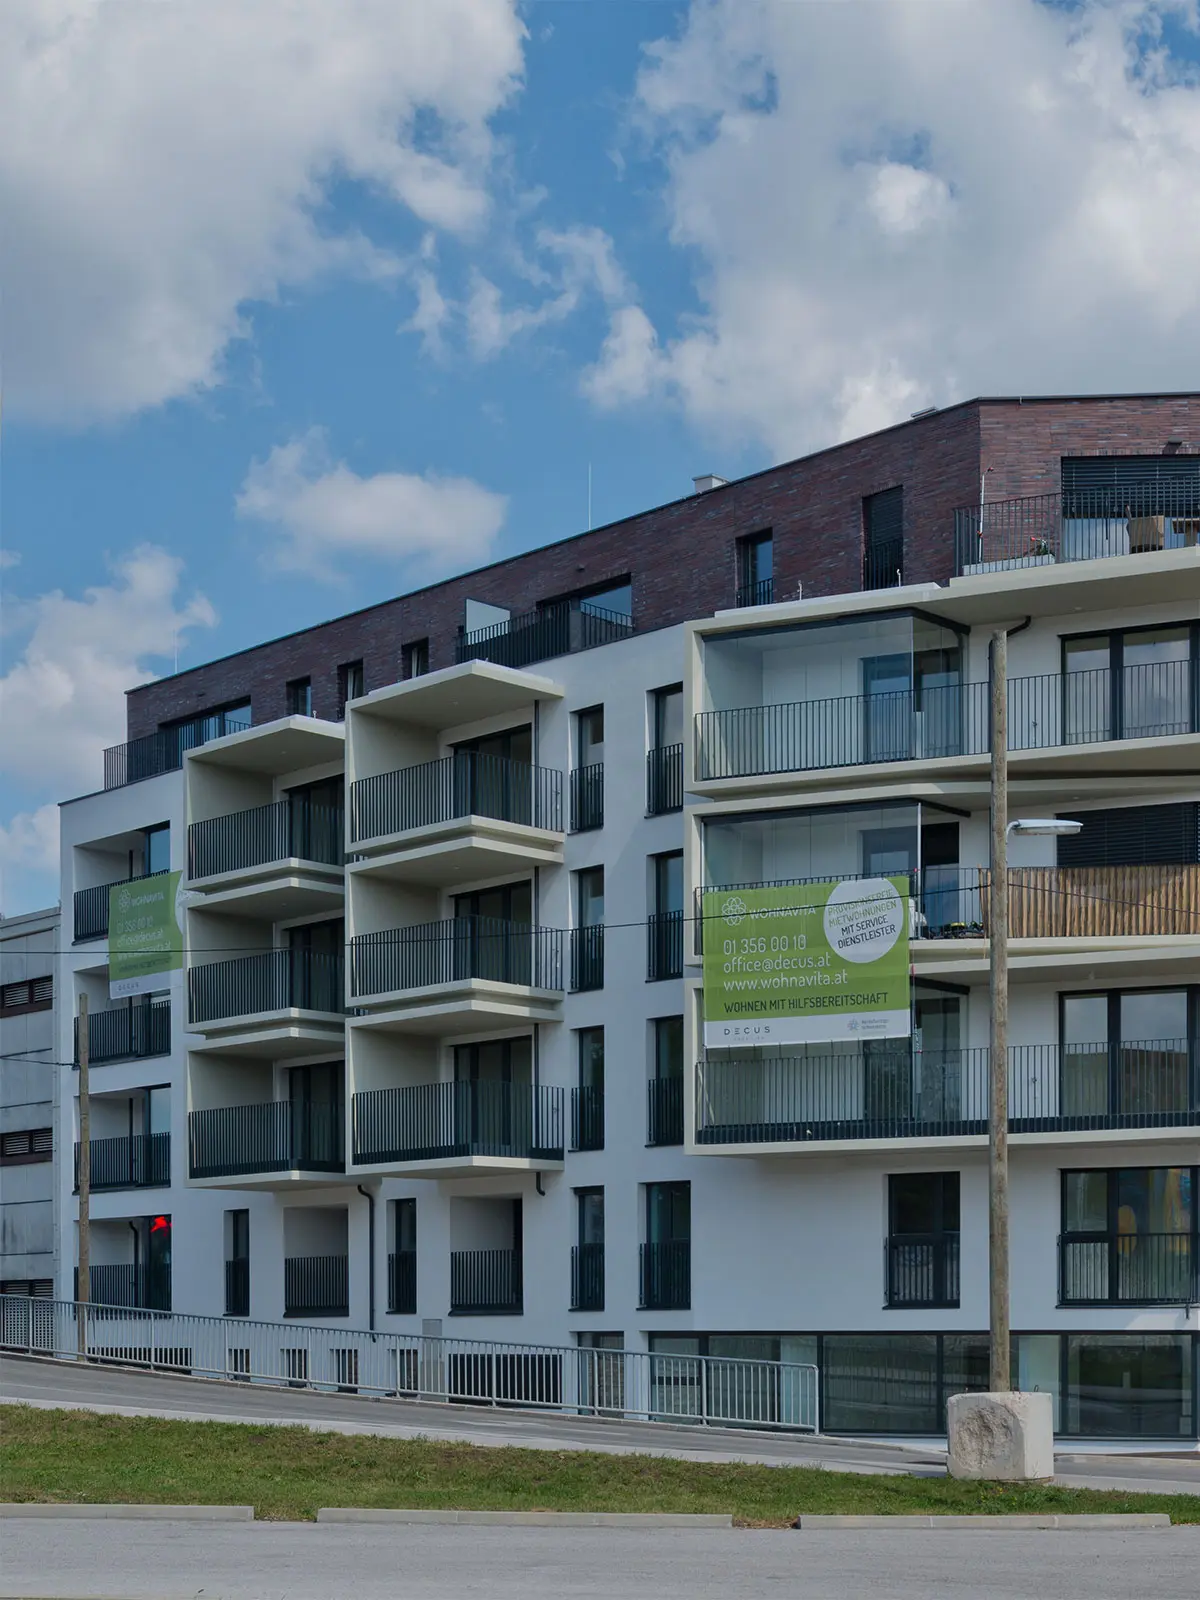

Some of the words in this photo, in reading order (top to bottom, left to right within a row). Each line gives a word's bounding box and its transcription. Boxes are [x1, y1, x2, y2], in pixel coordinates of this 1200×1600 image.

[749, 905, 816, 919] WOHNAVITA
[829, 900, 897, 927] MIETWOHNUNGEN
[841, 924, 854, 936] MIT
[856, 914, 889, 932] SERVICE
[723, 938, 736, 955] 01
[740, 937, 767, 954] 356
[770, 935, 789, 952] 00
[793, 934, 807, 951] 10
[837, 924, 896, 949] DIENSTLEISTER
[723, 952, 831, 973] office@decus.at
[723, 970, 848, 991] www.wohnavita.at
[724, 1000, 767, 1013] WOHNEN
[770, 999, 786, 1010] MIT
[788, 992, 888, 1009] HILFSBEREITSCHAFT
[724, 1026, 771, 1036] DECUS
